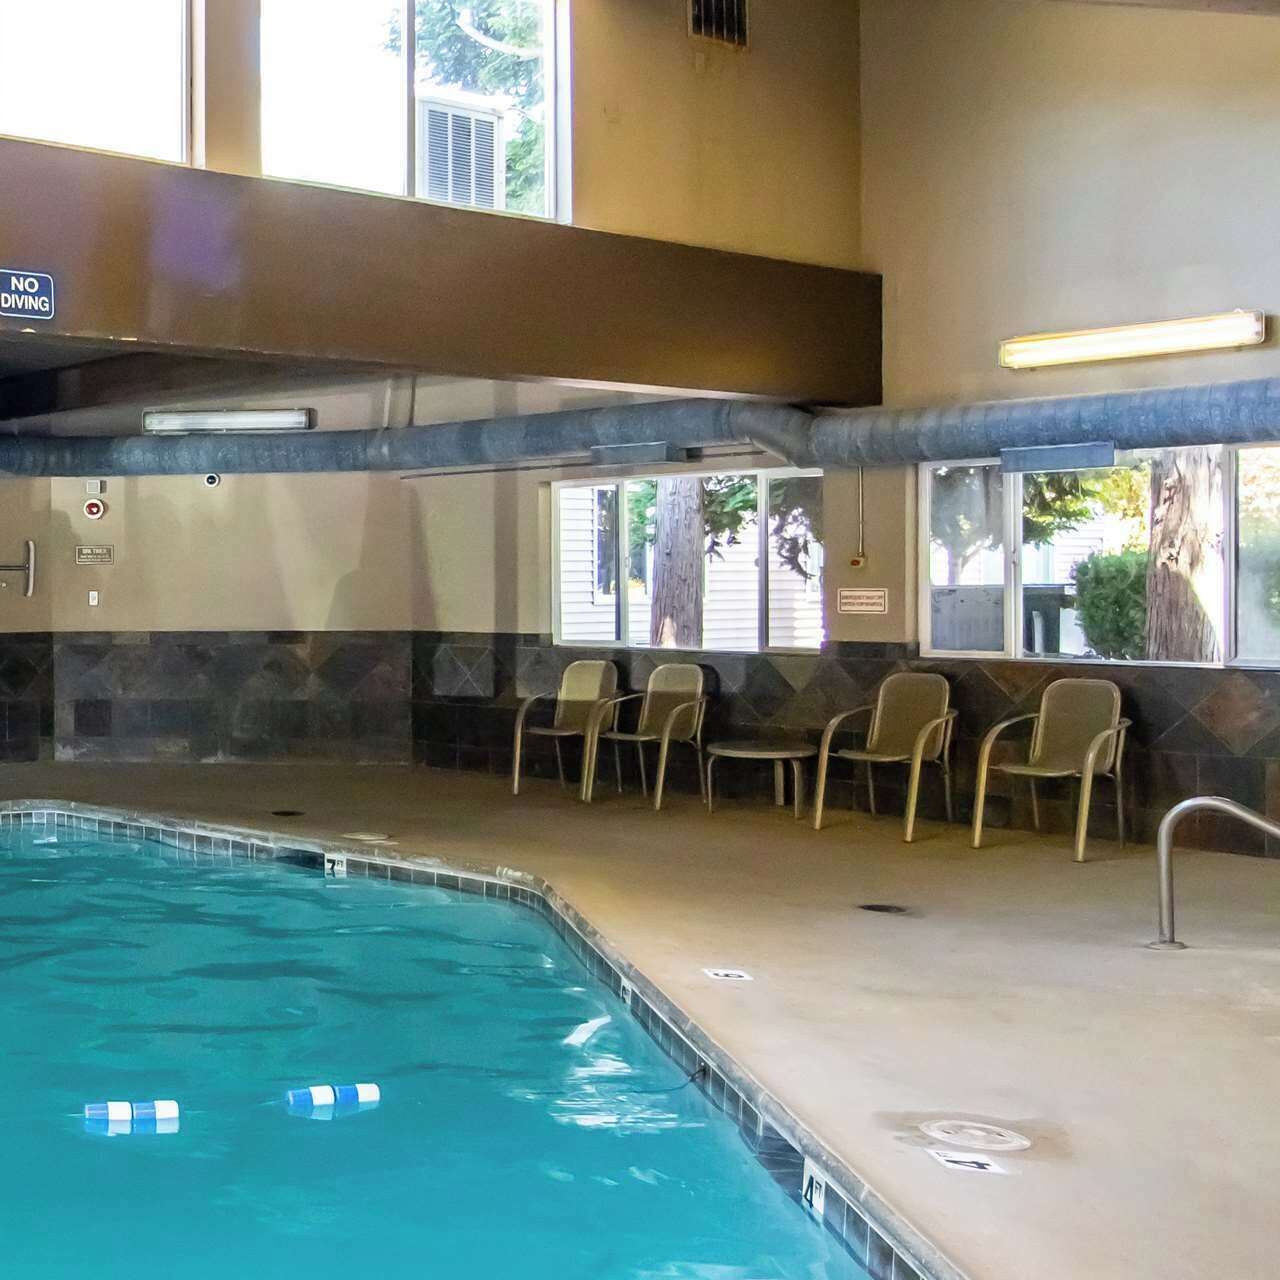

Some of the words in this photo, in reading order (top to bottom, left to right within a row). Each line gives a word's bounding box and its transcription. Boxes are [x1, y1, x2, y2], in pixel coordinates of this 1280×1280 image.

[10, 276, 39, 293] NO
[0, 292, 50, 312] DIVING
[326, 858, 337, 872] 7
[944, 1159, 992, 1170] 4
[803, 1174, 814, 1209] 4
